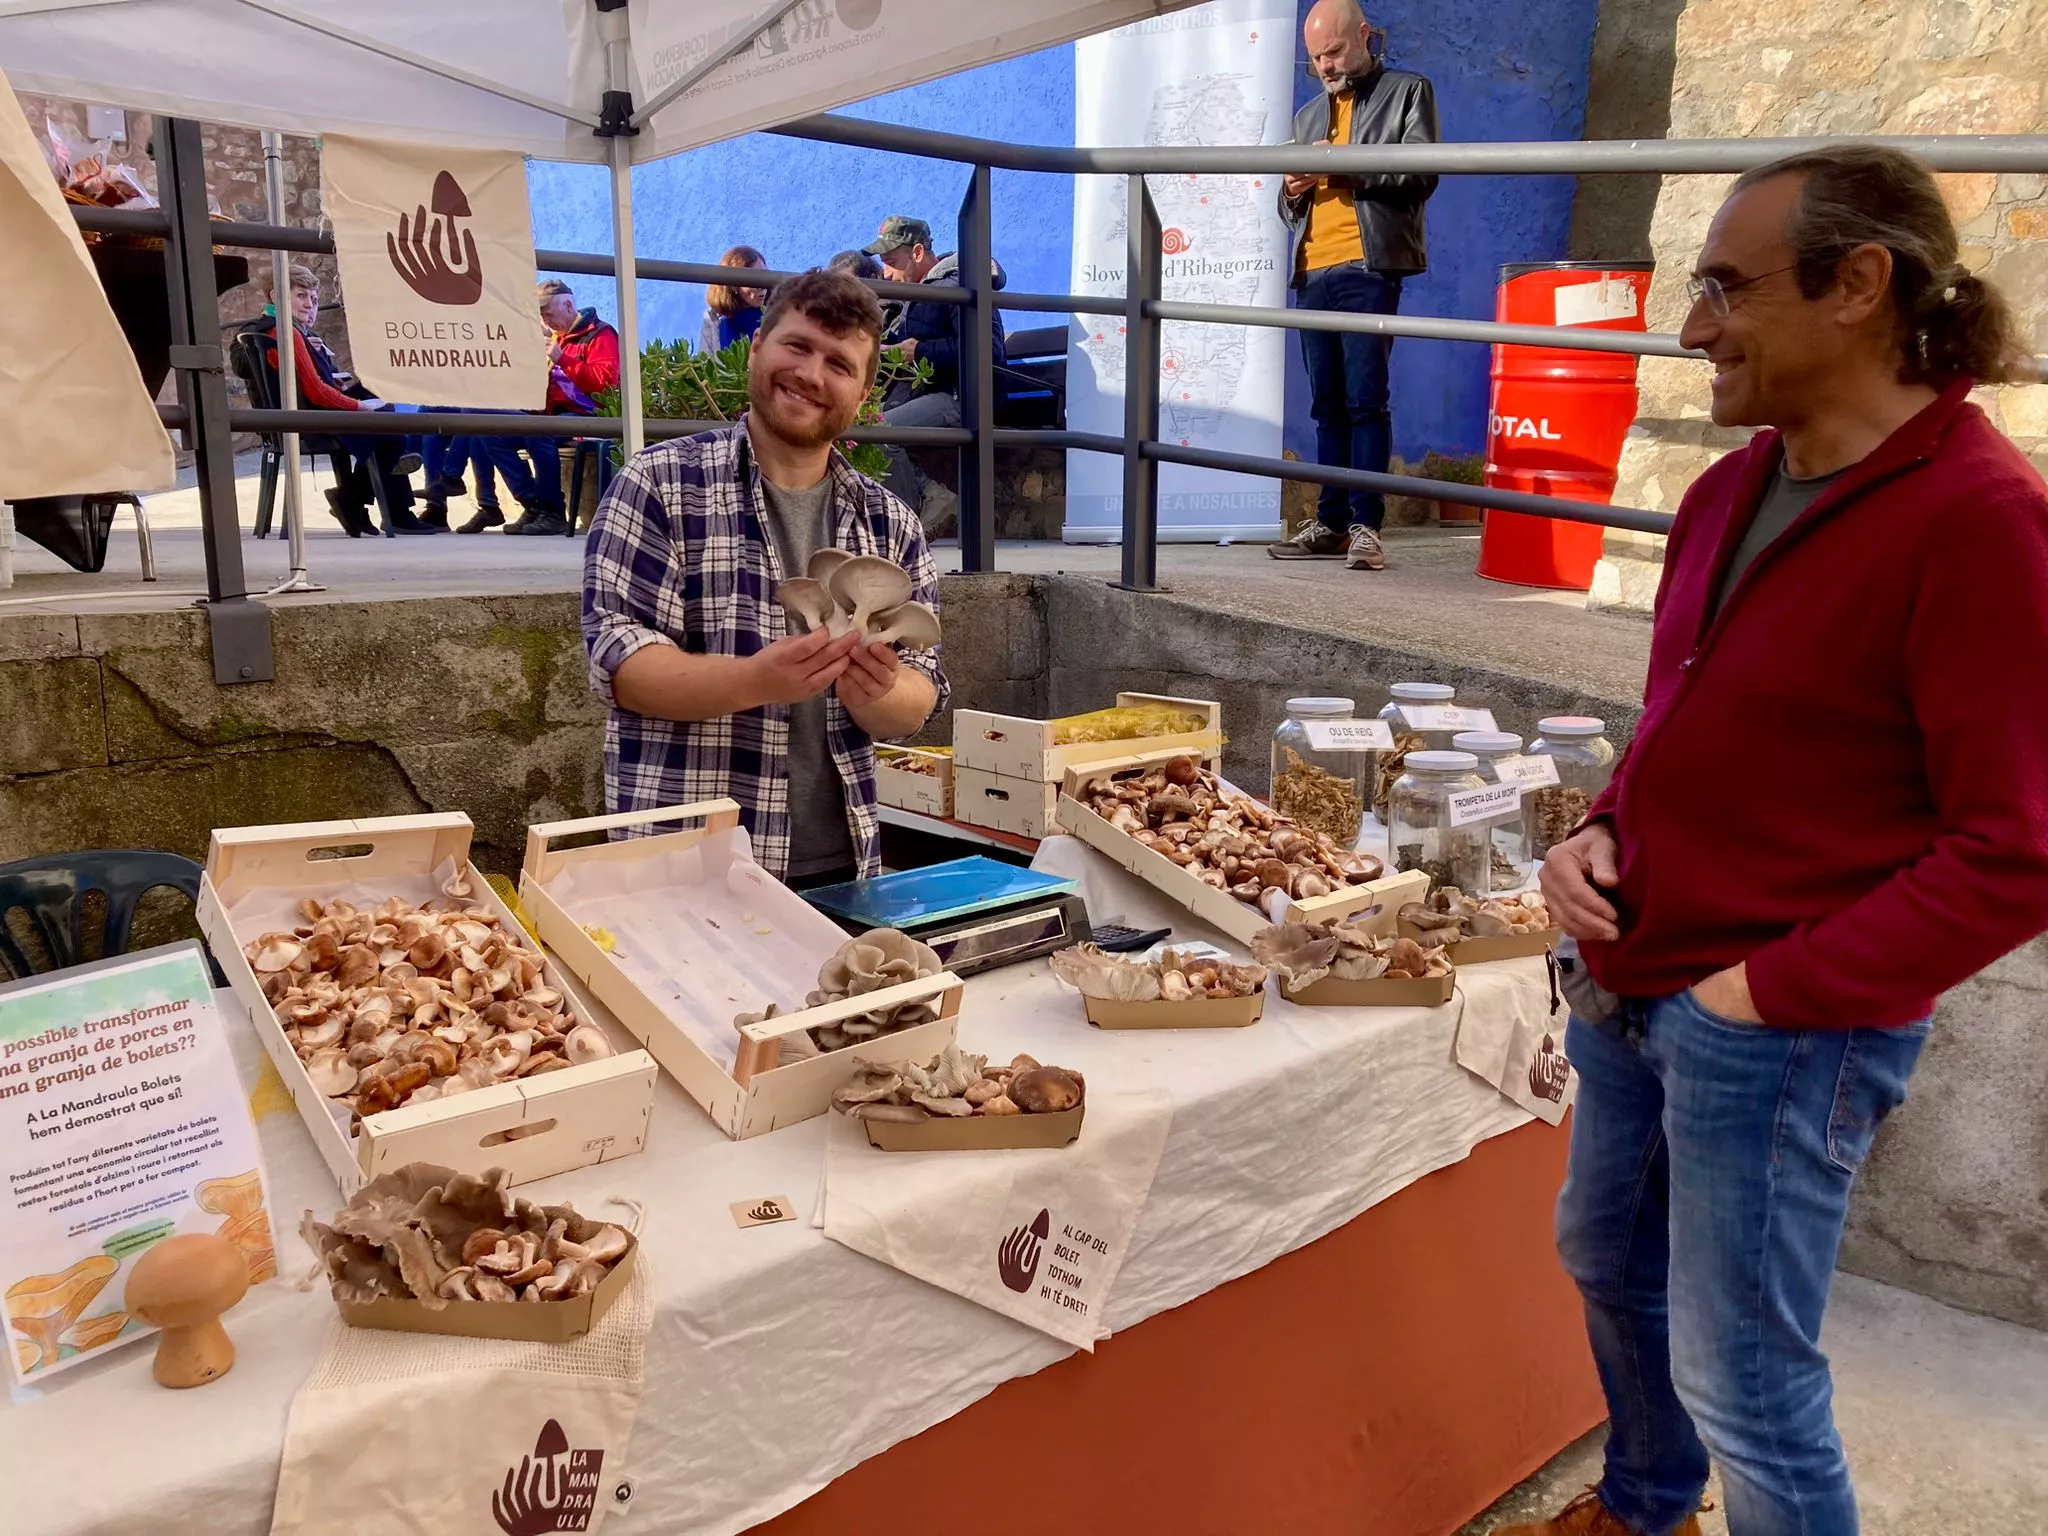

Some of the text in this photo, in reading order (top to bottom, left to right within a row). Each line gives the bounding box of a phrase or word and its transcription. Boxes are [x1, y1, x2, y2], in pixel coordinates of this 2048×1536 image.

[1141, 8, 1223, 34] NOSOTROS
[1081, 265, 1124, 282] Slow
[1182, 258, 1275, 280] Ribagorza
[385, 321, 507, 340] BOLETS LA
[389, 349, 511, 368] MANDRAULA
[1174, 494, 1186, 510] A
[1189, 492, 1278, 510] NOSALTRES
[1329, 727, 1373, 737] OU DE REIG
[1454, 794, 1485, 808] TROMPETA
[1486, 792, 1493, 802] DE
[1494, 790, 1501, 800] LA
[1502, 787, 1516, 798] MORT
[4, 999, 190, 1058] possible transformar
[27, 1044, 89, 1073] granja
[94, 1037, 115, 1053] de
[120, 1024, 168, 1049] porcs
[173, 1017, 193, 1032] en
[35, 1063, 96, 1093] granja
[101, 1055, 123, 1072] de
[127, 1033, 196, 1065] bolets??
[27, 1074, 182, 1125] A La Mandraula Bolets
[29, 1125, 61, 1140] hem
[65, 1101, 136, 1130] demostrat
[139, 1096, 165, 1110] que
[10, 1166, 51, 1183] Produïm
[52, 1160, 66, 1171] tot
[92, 1141, 133, 1158] diferents
[135, 1129, 175, 1144] varietats
[177, 1123, 188, 1132] de
[190, 1115, 217, 1128] bolets
[14, 1127, 220, 1195] fomentant una economia circular tot recollint
[18, 1193, 48, 1209] restes
[49, 1179, 93, 1199] forestals
[94, 1168, 130, 1185] d'alzina
[137, 1158, 161, 1172] roure
[168, 1144, 209, 1161] retornant
[210, 1138, 223, 1149] els
[49, 1196, 84, 1213] residus
[94, 1185, 118, 1198] l'hort
[120, 1180, 136, 1192] per
[138, 1177, 144, 1185] a
[145, 1171, 159, 1182] fer
[161, 1158, 202, 1177] compost.
[1062, 1224, 1108, 1255] AL CAP DEL
[1054, 1243, 1080, 1266] BOLET,
[1048, 1264, 1082, 1289] TOTHOM
[1041, 1285, 1088, 1316] HI TÉ DRET!
[572, 1451, 587, 1467] LA
[568, 1472, 599, 1488] MAN
[563, 1494, 592, 1509] DRA
[556, 1513, 586, 1529] ULA
